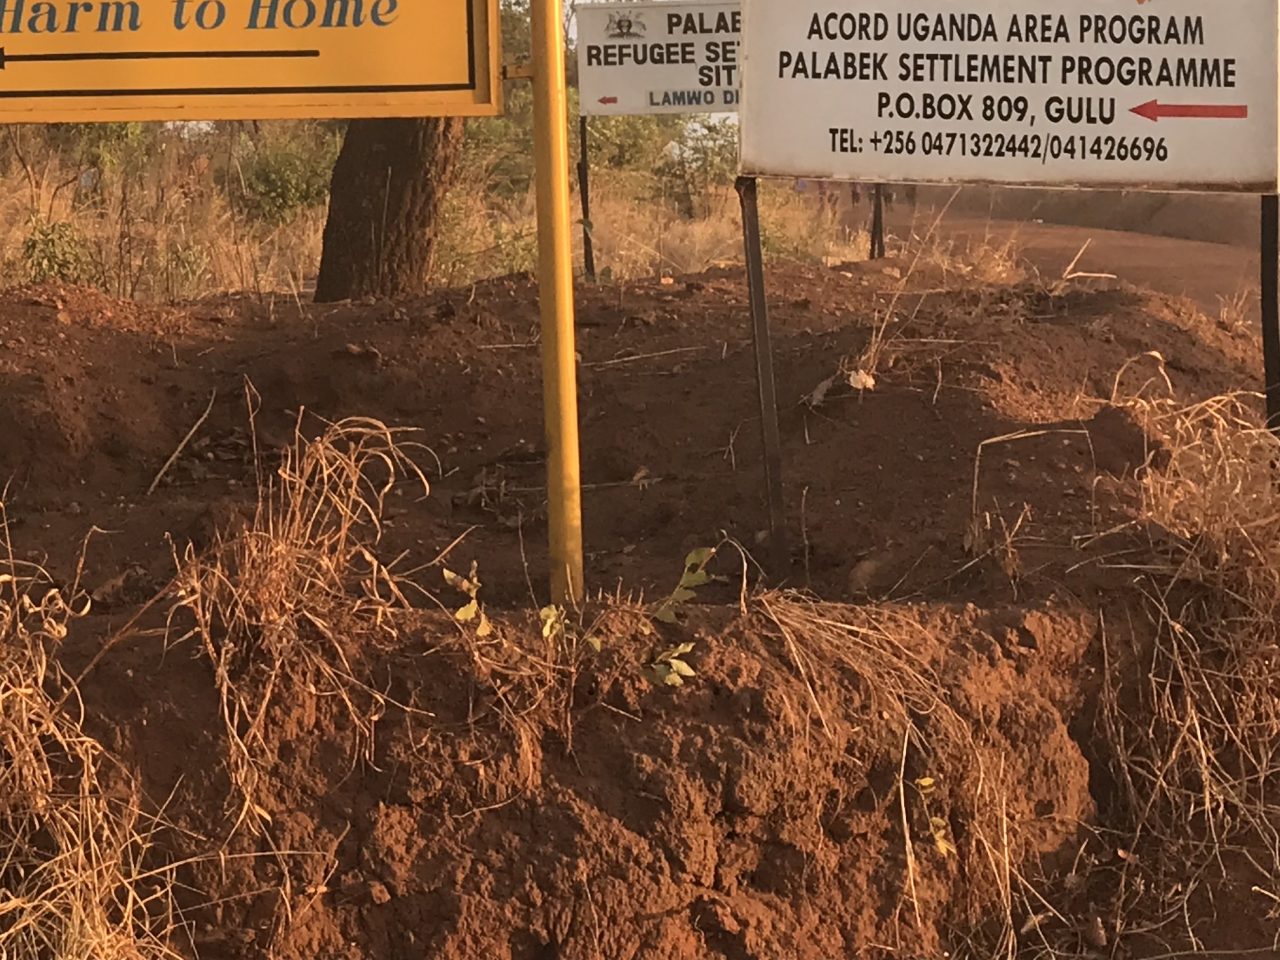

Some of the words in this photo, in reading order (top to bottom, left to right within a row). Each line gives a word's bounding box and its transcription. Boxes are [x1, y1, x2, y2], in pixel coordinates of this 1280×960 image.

[806, 12, 889, 42] ACORD
[897, 12, 999, 43] UGANDA
[1006, 13, 1071, 44] AREA
[1079, 14, 1204, 45] PROGRAM
[586, 41, 696, 67] REFUGEE
[778, 50, 889, 81] PALABEK
[898, 52, 1053, 84] SETTLEMENT
[1061, 55, 1236, 88] PROGRAMME
[649, 90, 715, 107] LAMWO
[877, 91, 974, 121] P.O.BOX
[981, 95, 1036, 127] 809,
[1044, 95, 1116, 125] GULU
[828, 127, 863, 153] TEL:
[869, 129, 917, 155] +256
[921, 131, 1168, 165] 0471322442/041426696
